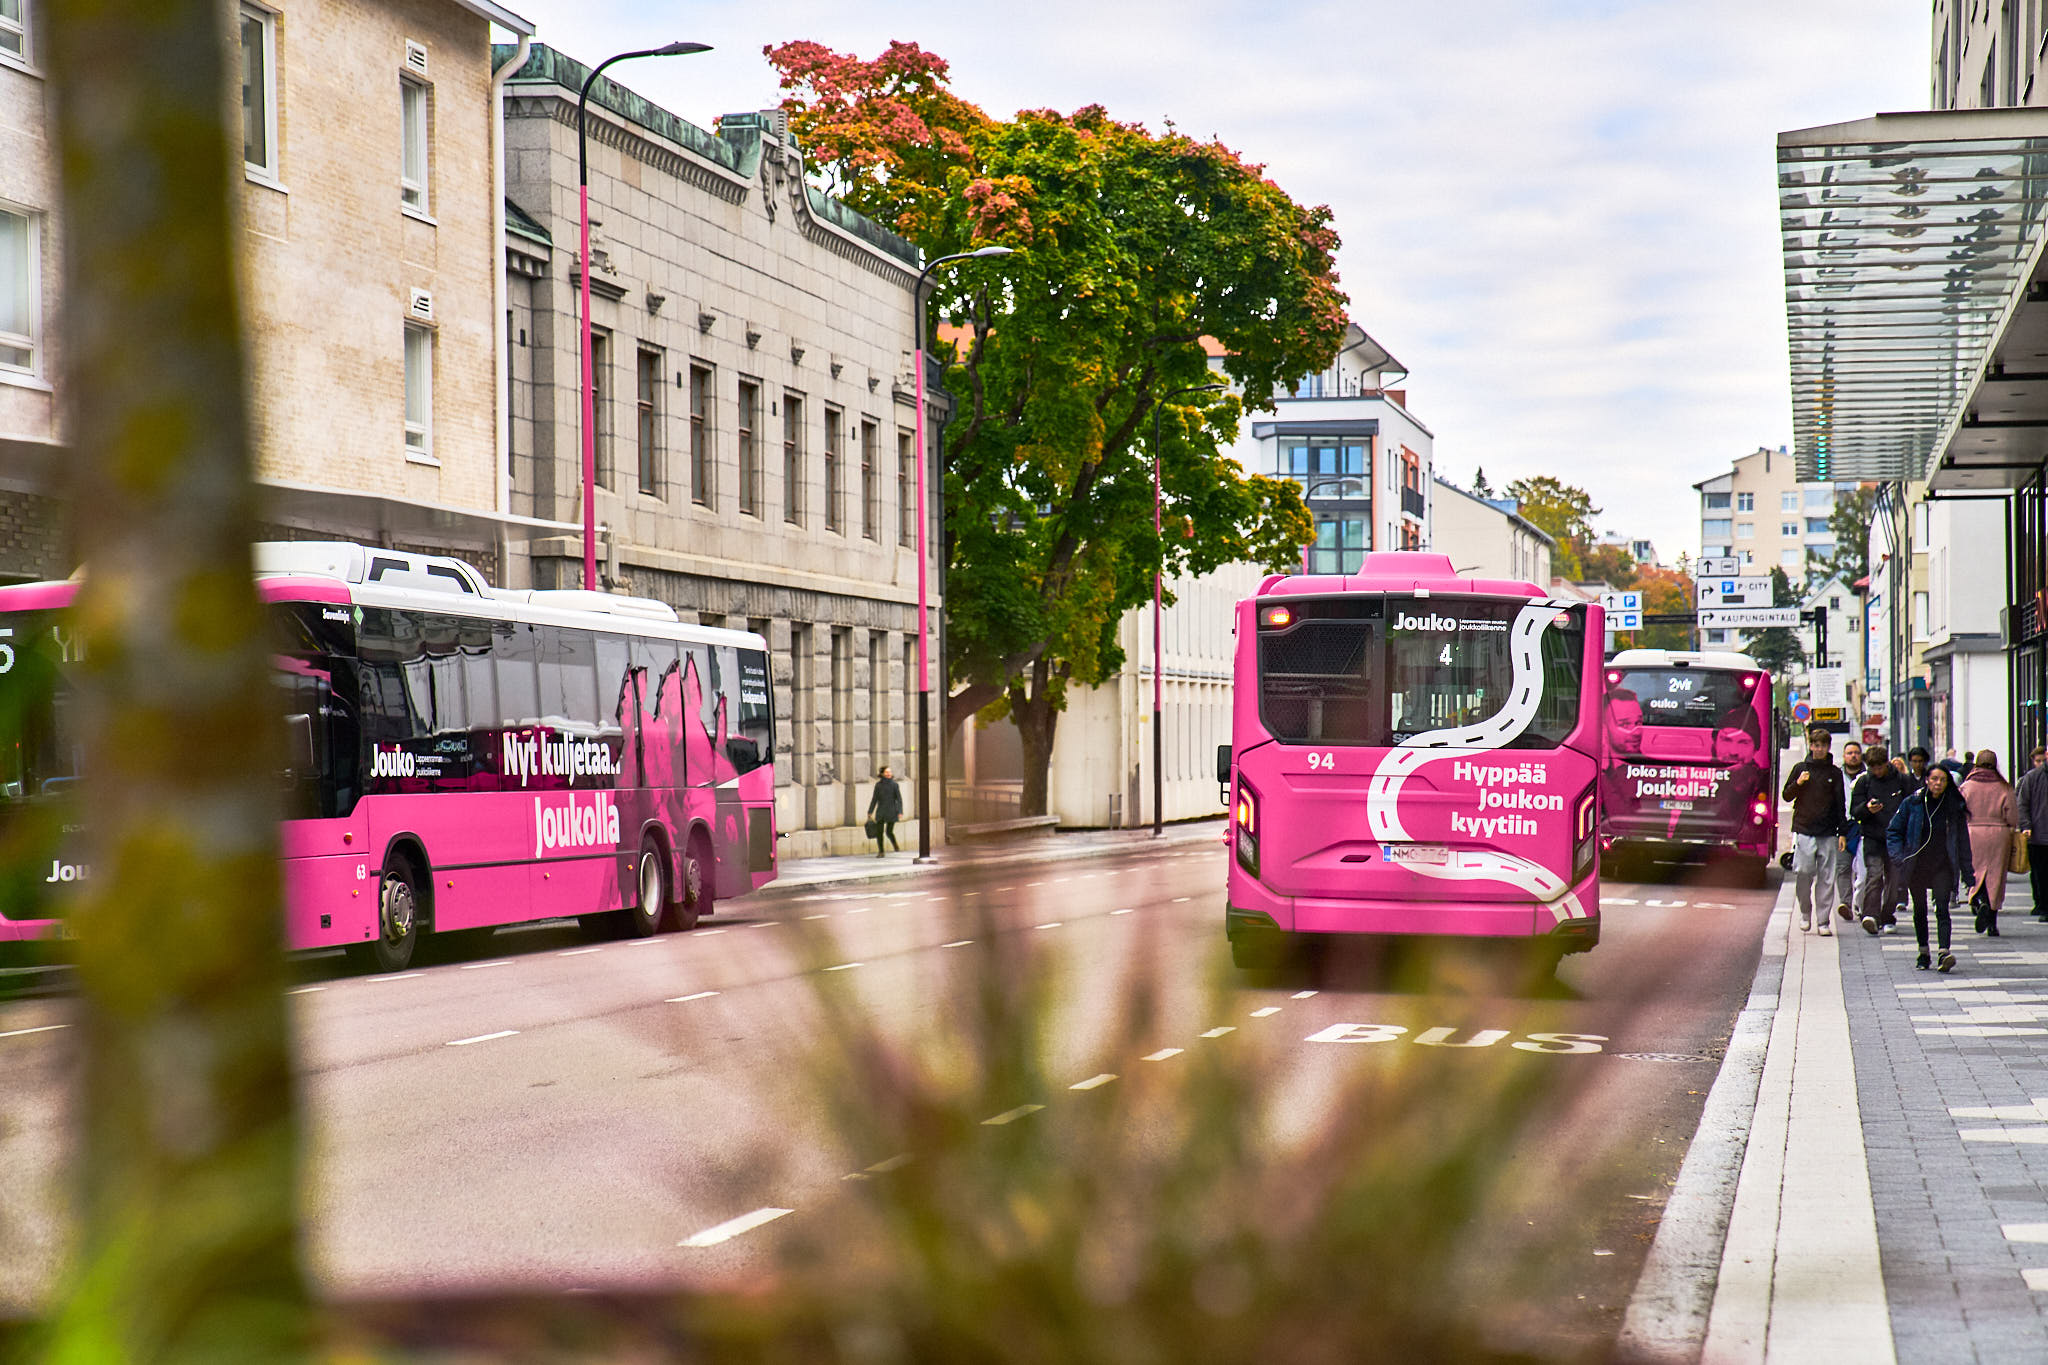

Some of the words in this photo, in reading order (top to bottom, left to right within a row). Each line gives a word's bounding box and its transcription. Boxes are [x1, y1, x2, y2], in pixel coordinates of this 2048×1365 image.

[1392, 612, 1457, 632] Jouko
[1721, 613, 1797, 623] KAUPUNGINTALO
[1439, 643, 1453, 666] 4
[370, 743, 415, 778] Jouko
[503, 732, 539, 788] Nyt
[1307, 752, 1335, 770] 94
[1453, 761, 1547, 788] Hyppää
[1626, 765, 1658, 780] Joko
[1659, 766, 1688, 779] sinä
[1690, 767, 1731, 781] kuljet
[1478, 788, 1564, 812] Joukon
[1635, 779, 1720, 799] Joukolla?
[534, 792, 621, 859] Joukolla
[1451, 811, 1538, 838] kyytiin
[45, 859, 91, 883] Jou
[356, 863, 366, 881] 63
[1599, 897, 1737, 910] BUS
[1303, 1022, 1610, 1055] BUS
